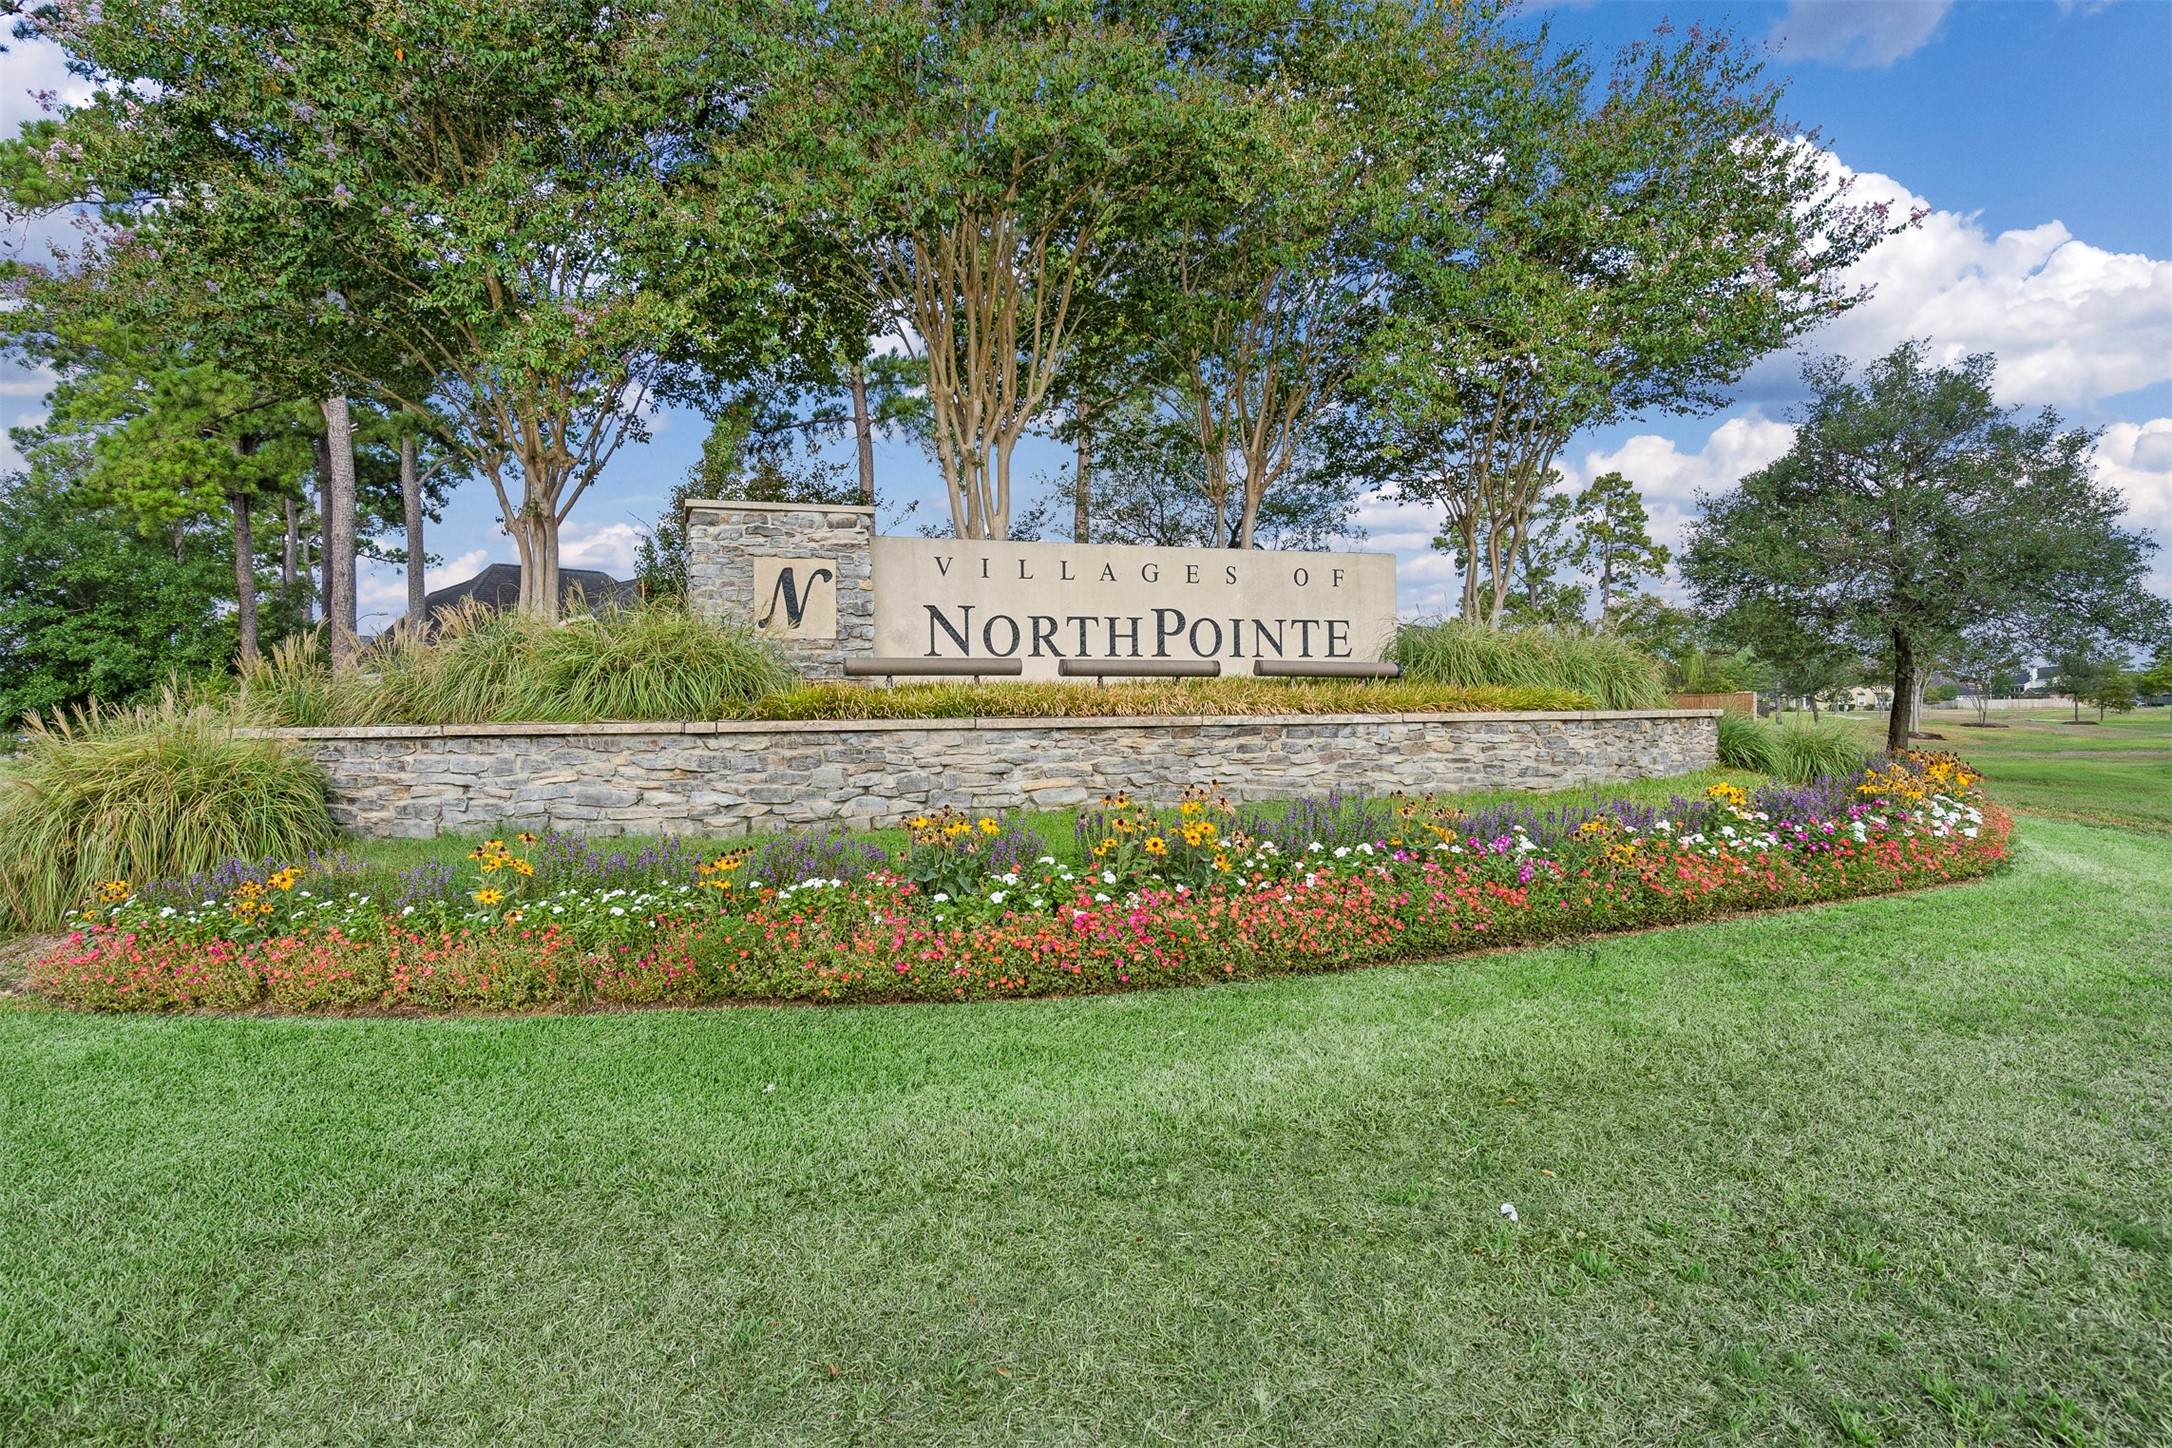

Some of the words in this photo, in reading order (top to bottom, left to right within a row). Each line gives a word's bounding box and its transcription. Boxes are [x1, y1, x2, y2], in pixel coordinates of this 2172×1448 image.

[934, 556, 1237, 585] VILLAGES
[1294, 567, 1345, 588] OF
[758, 567, 833, 629] N
